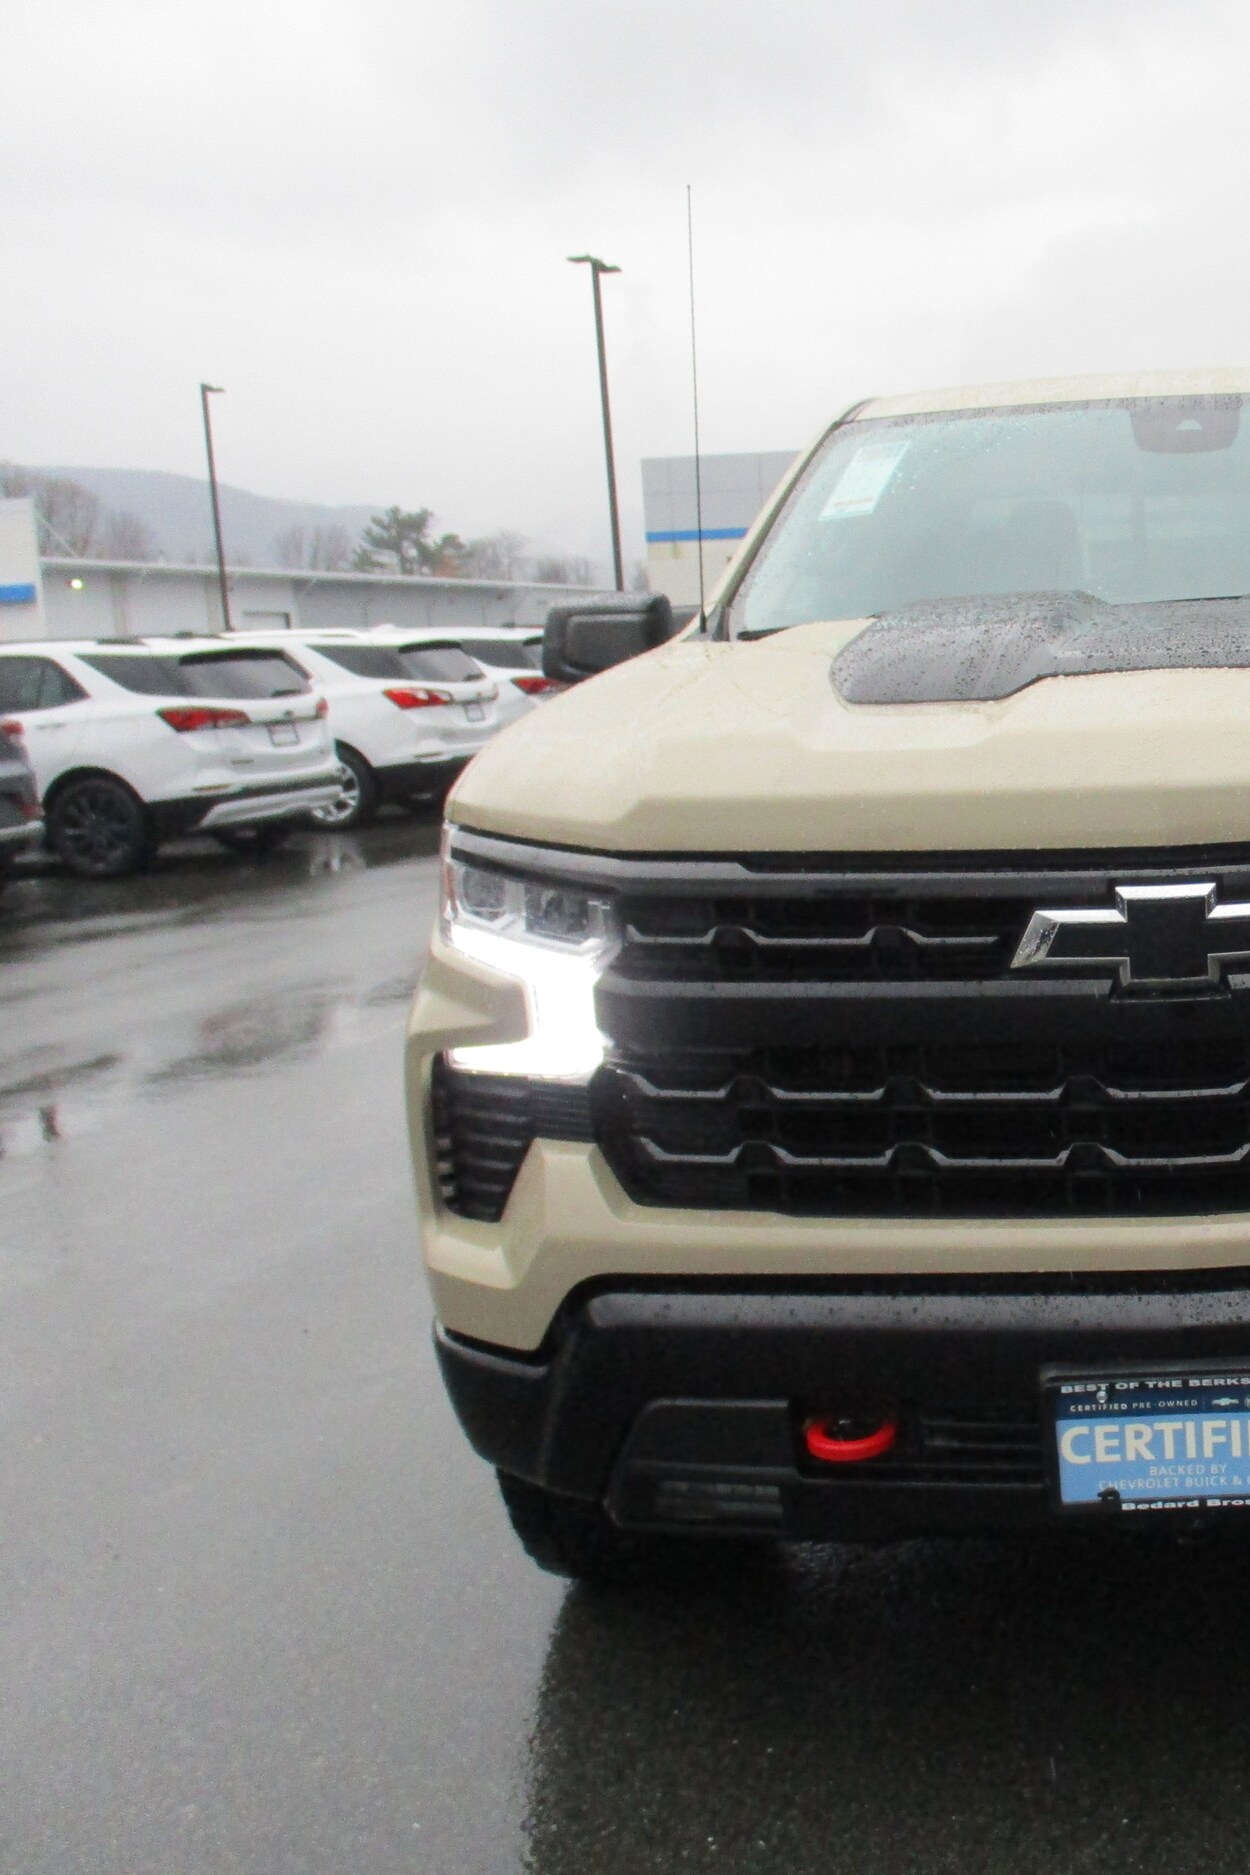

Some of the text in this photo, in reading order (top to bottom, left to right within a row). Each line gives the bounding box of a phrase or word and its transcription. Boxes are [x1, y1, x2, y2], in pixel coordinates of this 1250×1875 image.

[1061, 1383, 1109, 1394] BEST
[1115, 1381, 1139, 1390] OF
[1145, 1380, 1182, 1389] THE
[1070, 1402, 1128, 1412] CERTIFIED
[1149, 1464, 1227, 1477] BACKED BY
[1099, 1477, 1179, 1490] CHEVROLET
[1185, 1475, 1227, 1487] BUICK
[1232, 1475, 1242, 1485] &
[1121, 1500, 1199, 1511] Bedard
